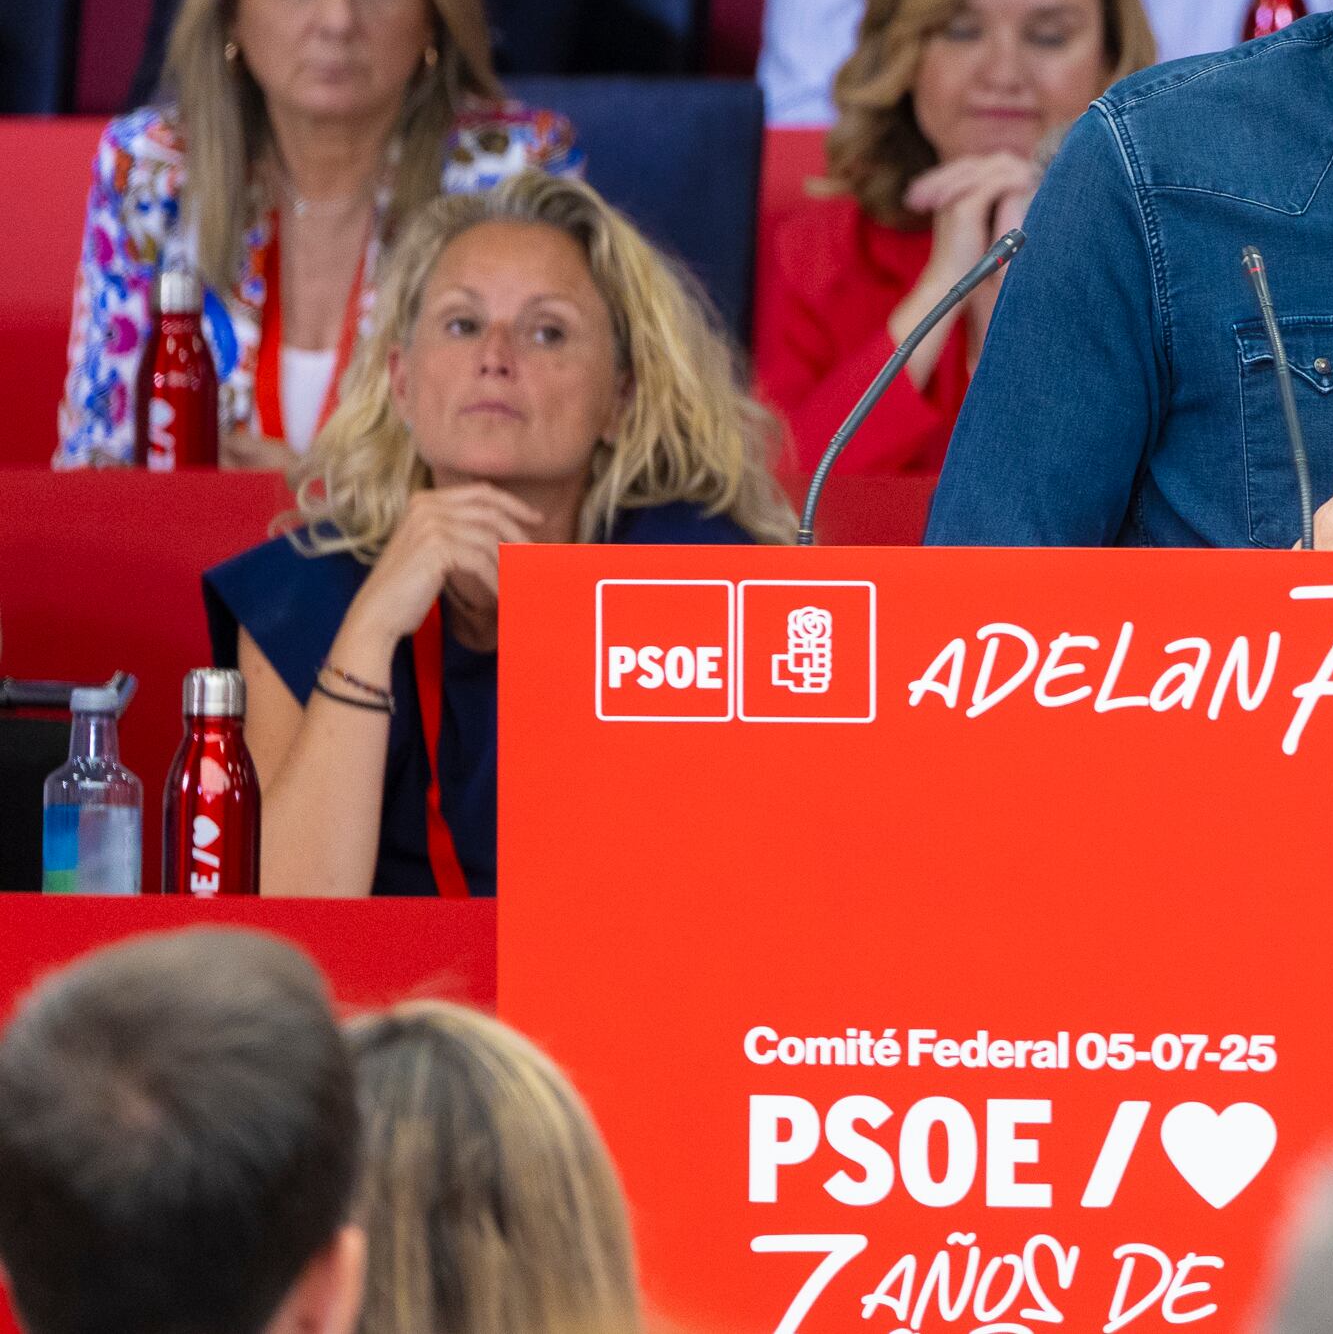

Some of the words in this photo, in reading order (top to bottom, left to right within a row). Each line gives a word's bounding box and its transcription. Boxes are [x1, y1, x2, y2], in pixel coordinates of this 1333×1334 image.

[608, 645, 723, 689] PSOE
[743, 1025, 902, 1068] Comité
[908, 1029, 1070, 1071] Federal
[1075, 1032, 1278, 1073] 05-07-25
[748, 1094, 1053, 1209] PSOE
[861, 1232, 1080, 1330] AÑOS
[1102, 1242, 1225, 1334] DE
